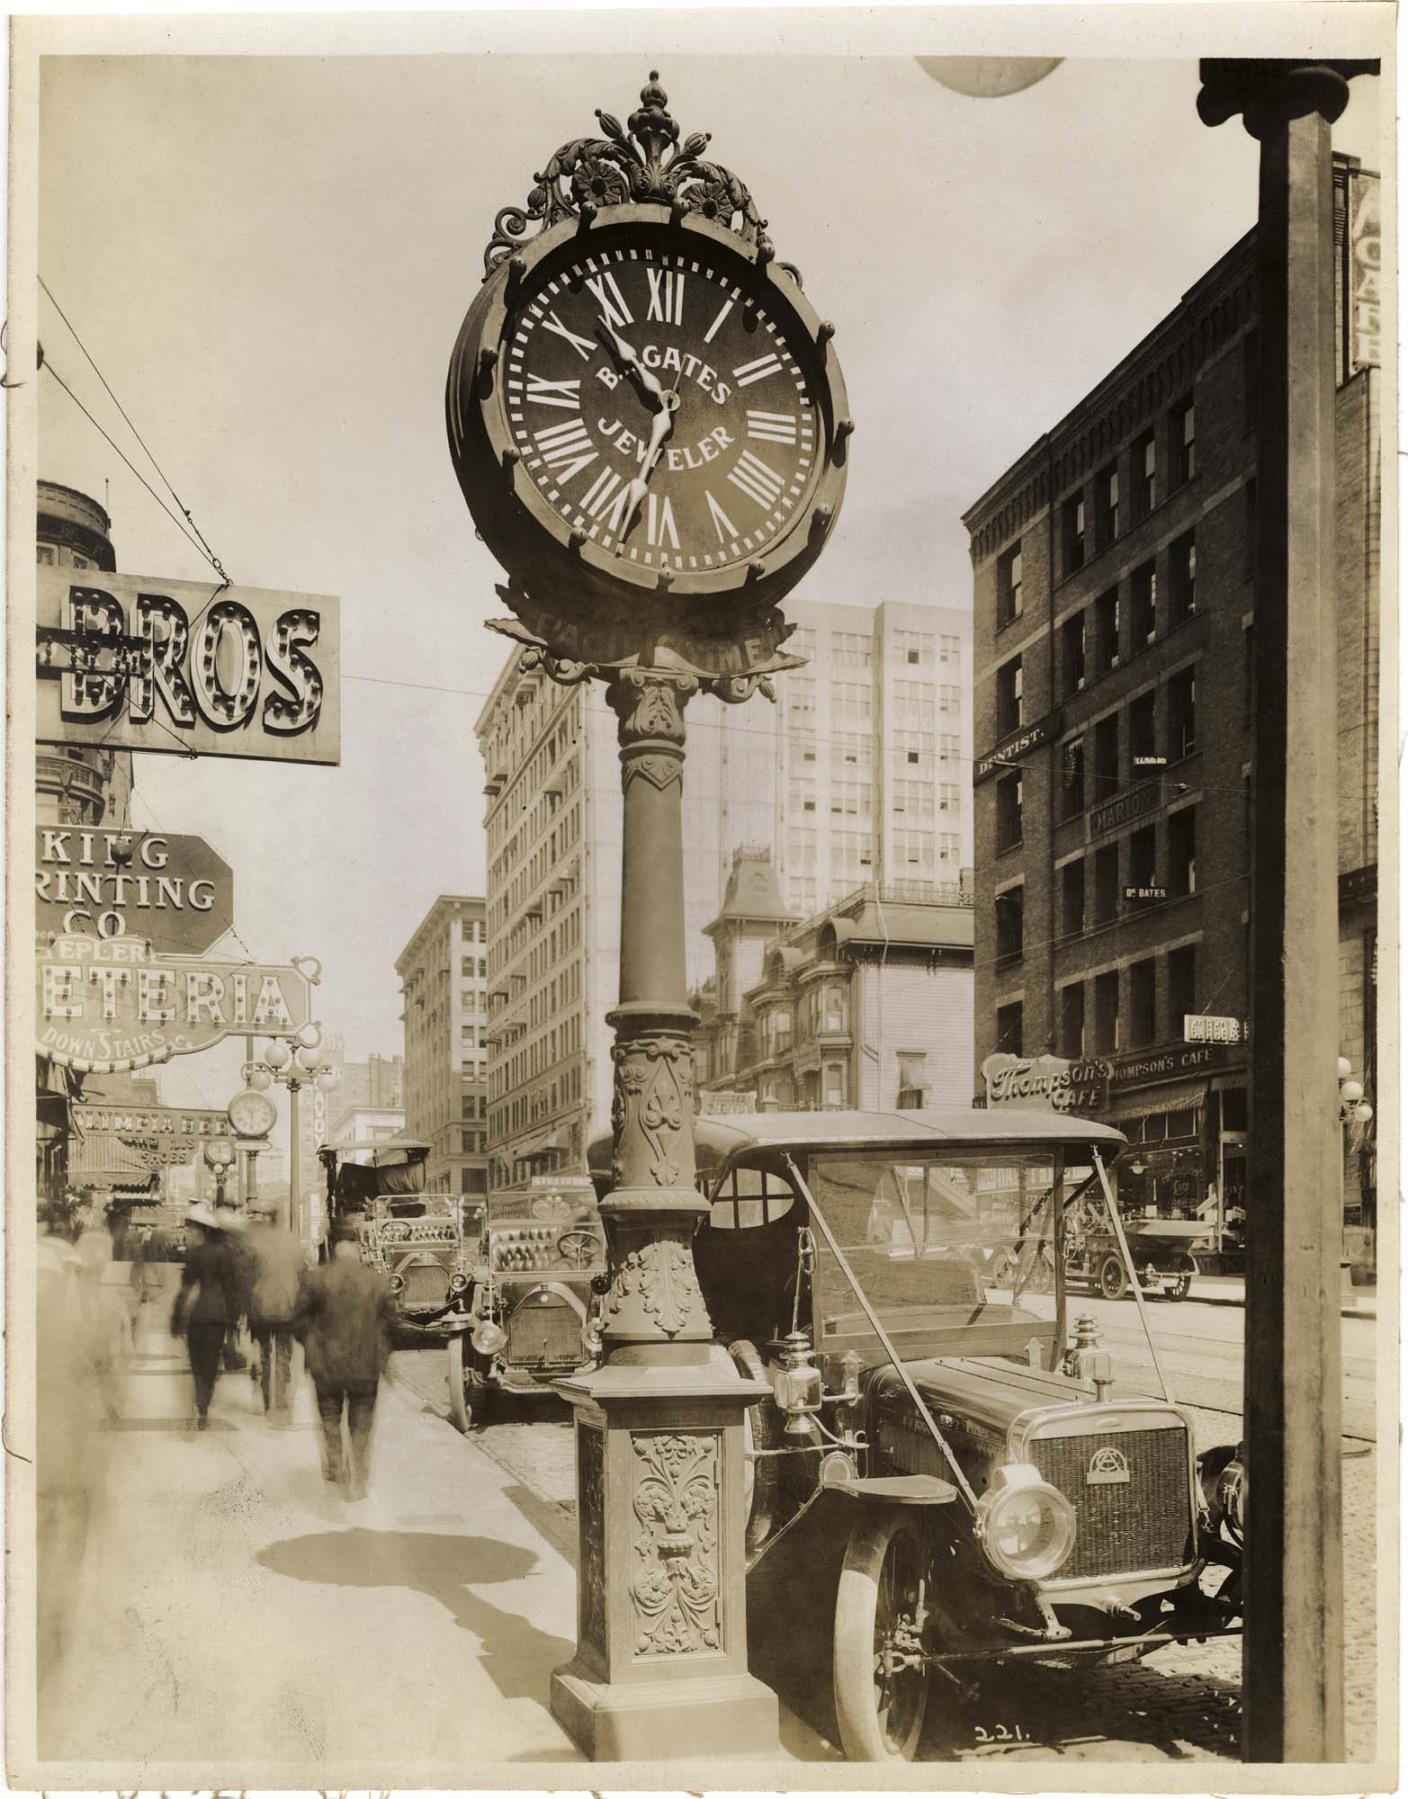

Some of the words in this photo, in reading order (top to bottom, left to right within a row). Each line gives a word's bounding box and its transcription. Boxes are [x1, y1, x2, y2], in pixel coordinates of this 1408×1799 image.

[647, 268, 685, 326] XII
[541, 311, 598, 362] X
[527, 373, 580, 409] IX
[642, 344, 732, 405] GATES
[597, 417, 736, 471] JEWELER
[746, 410, 796, 445] III
[61, 585, 323, 737] BROS
[1139, 888, 1166, 898] BATES
[42, 965, 294, 1025] ETERIA
[990, 1060, 1107, 1102] Thompson's
